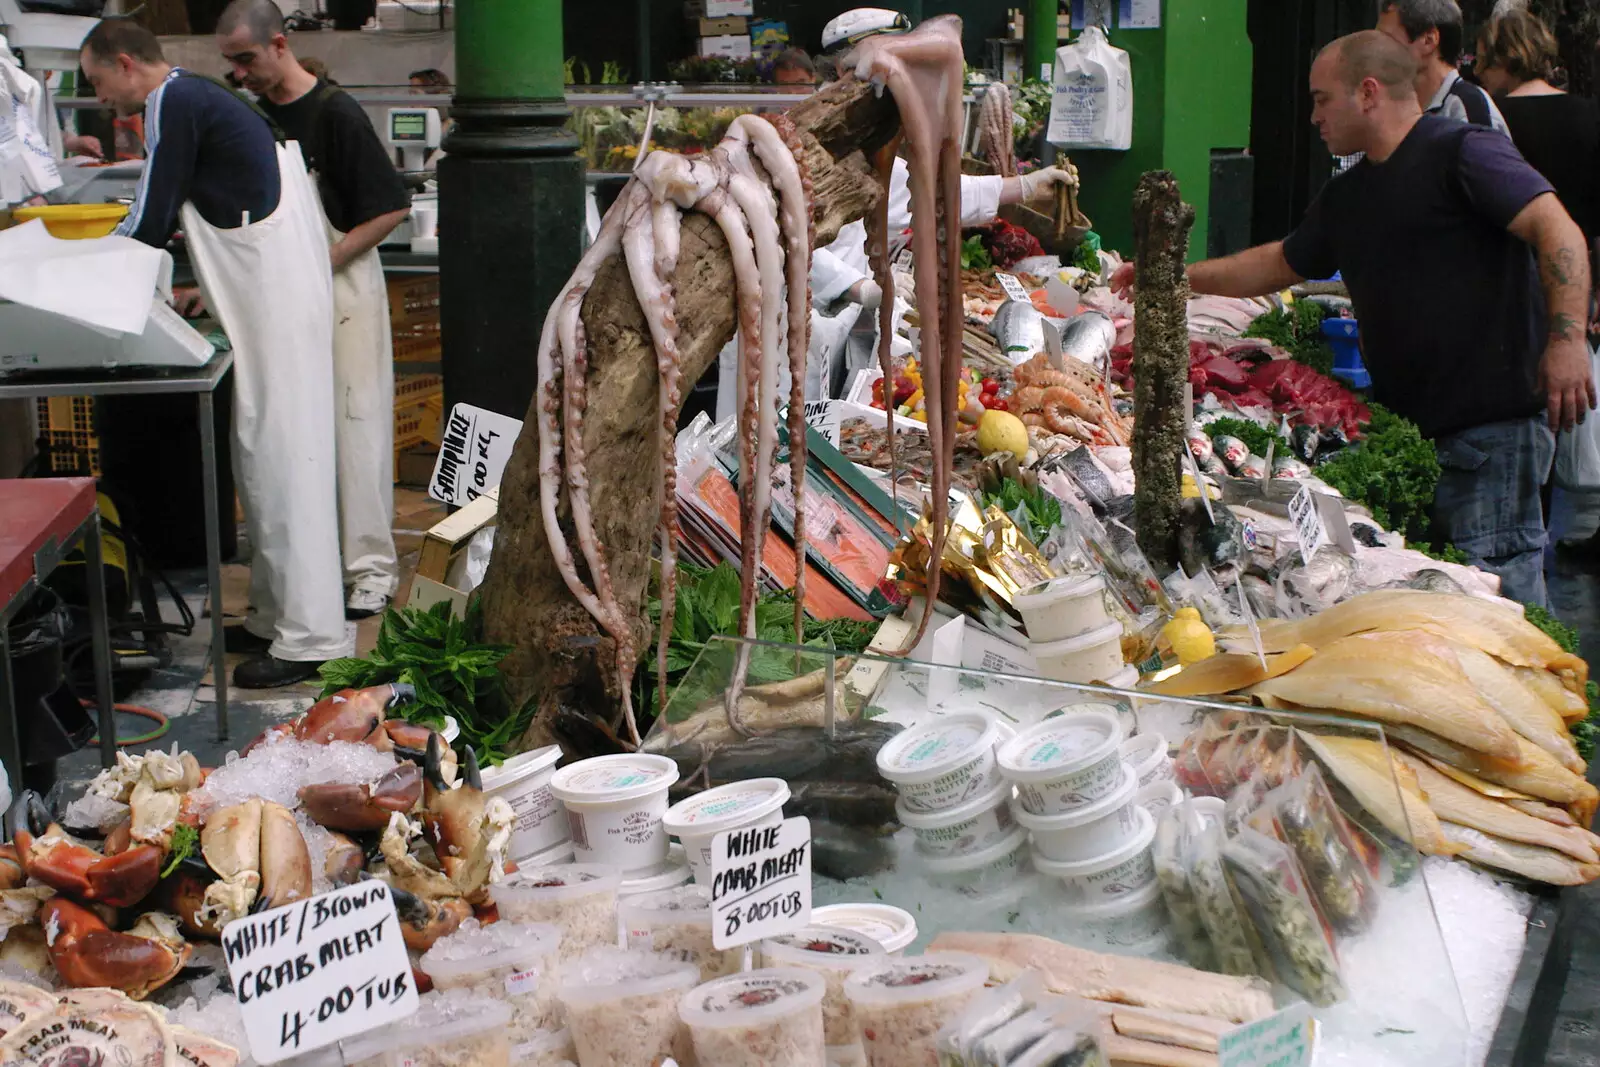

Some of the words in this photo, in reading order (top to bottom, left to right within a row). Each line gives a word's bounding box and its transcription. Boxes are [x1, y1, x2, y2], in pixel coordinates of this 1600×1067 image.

[727, 824, 782, 859] WHITE
[712, 862, 758, 902] CRAB
[761, 839, 810, 886] MEAT
[238, 953, 315, 1004] CRAB
[318, 913, 391, 968] MEAT
[356, 972, 408, 1011] TUB
[19, 1023, 65, 1054] CRAB
[68, 1019, 119, 1041] MEAT
